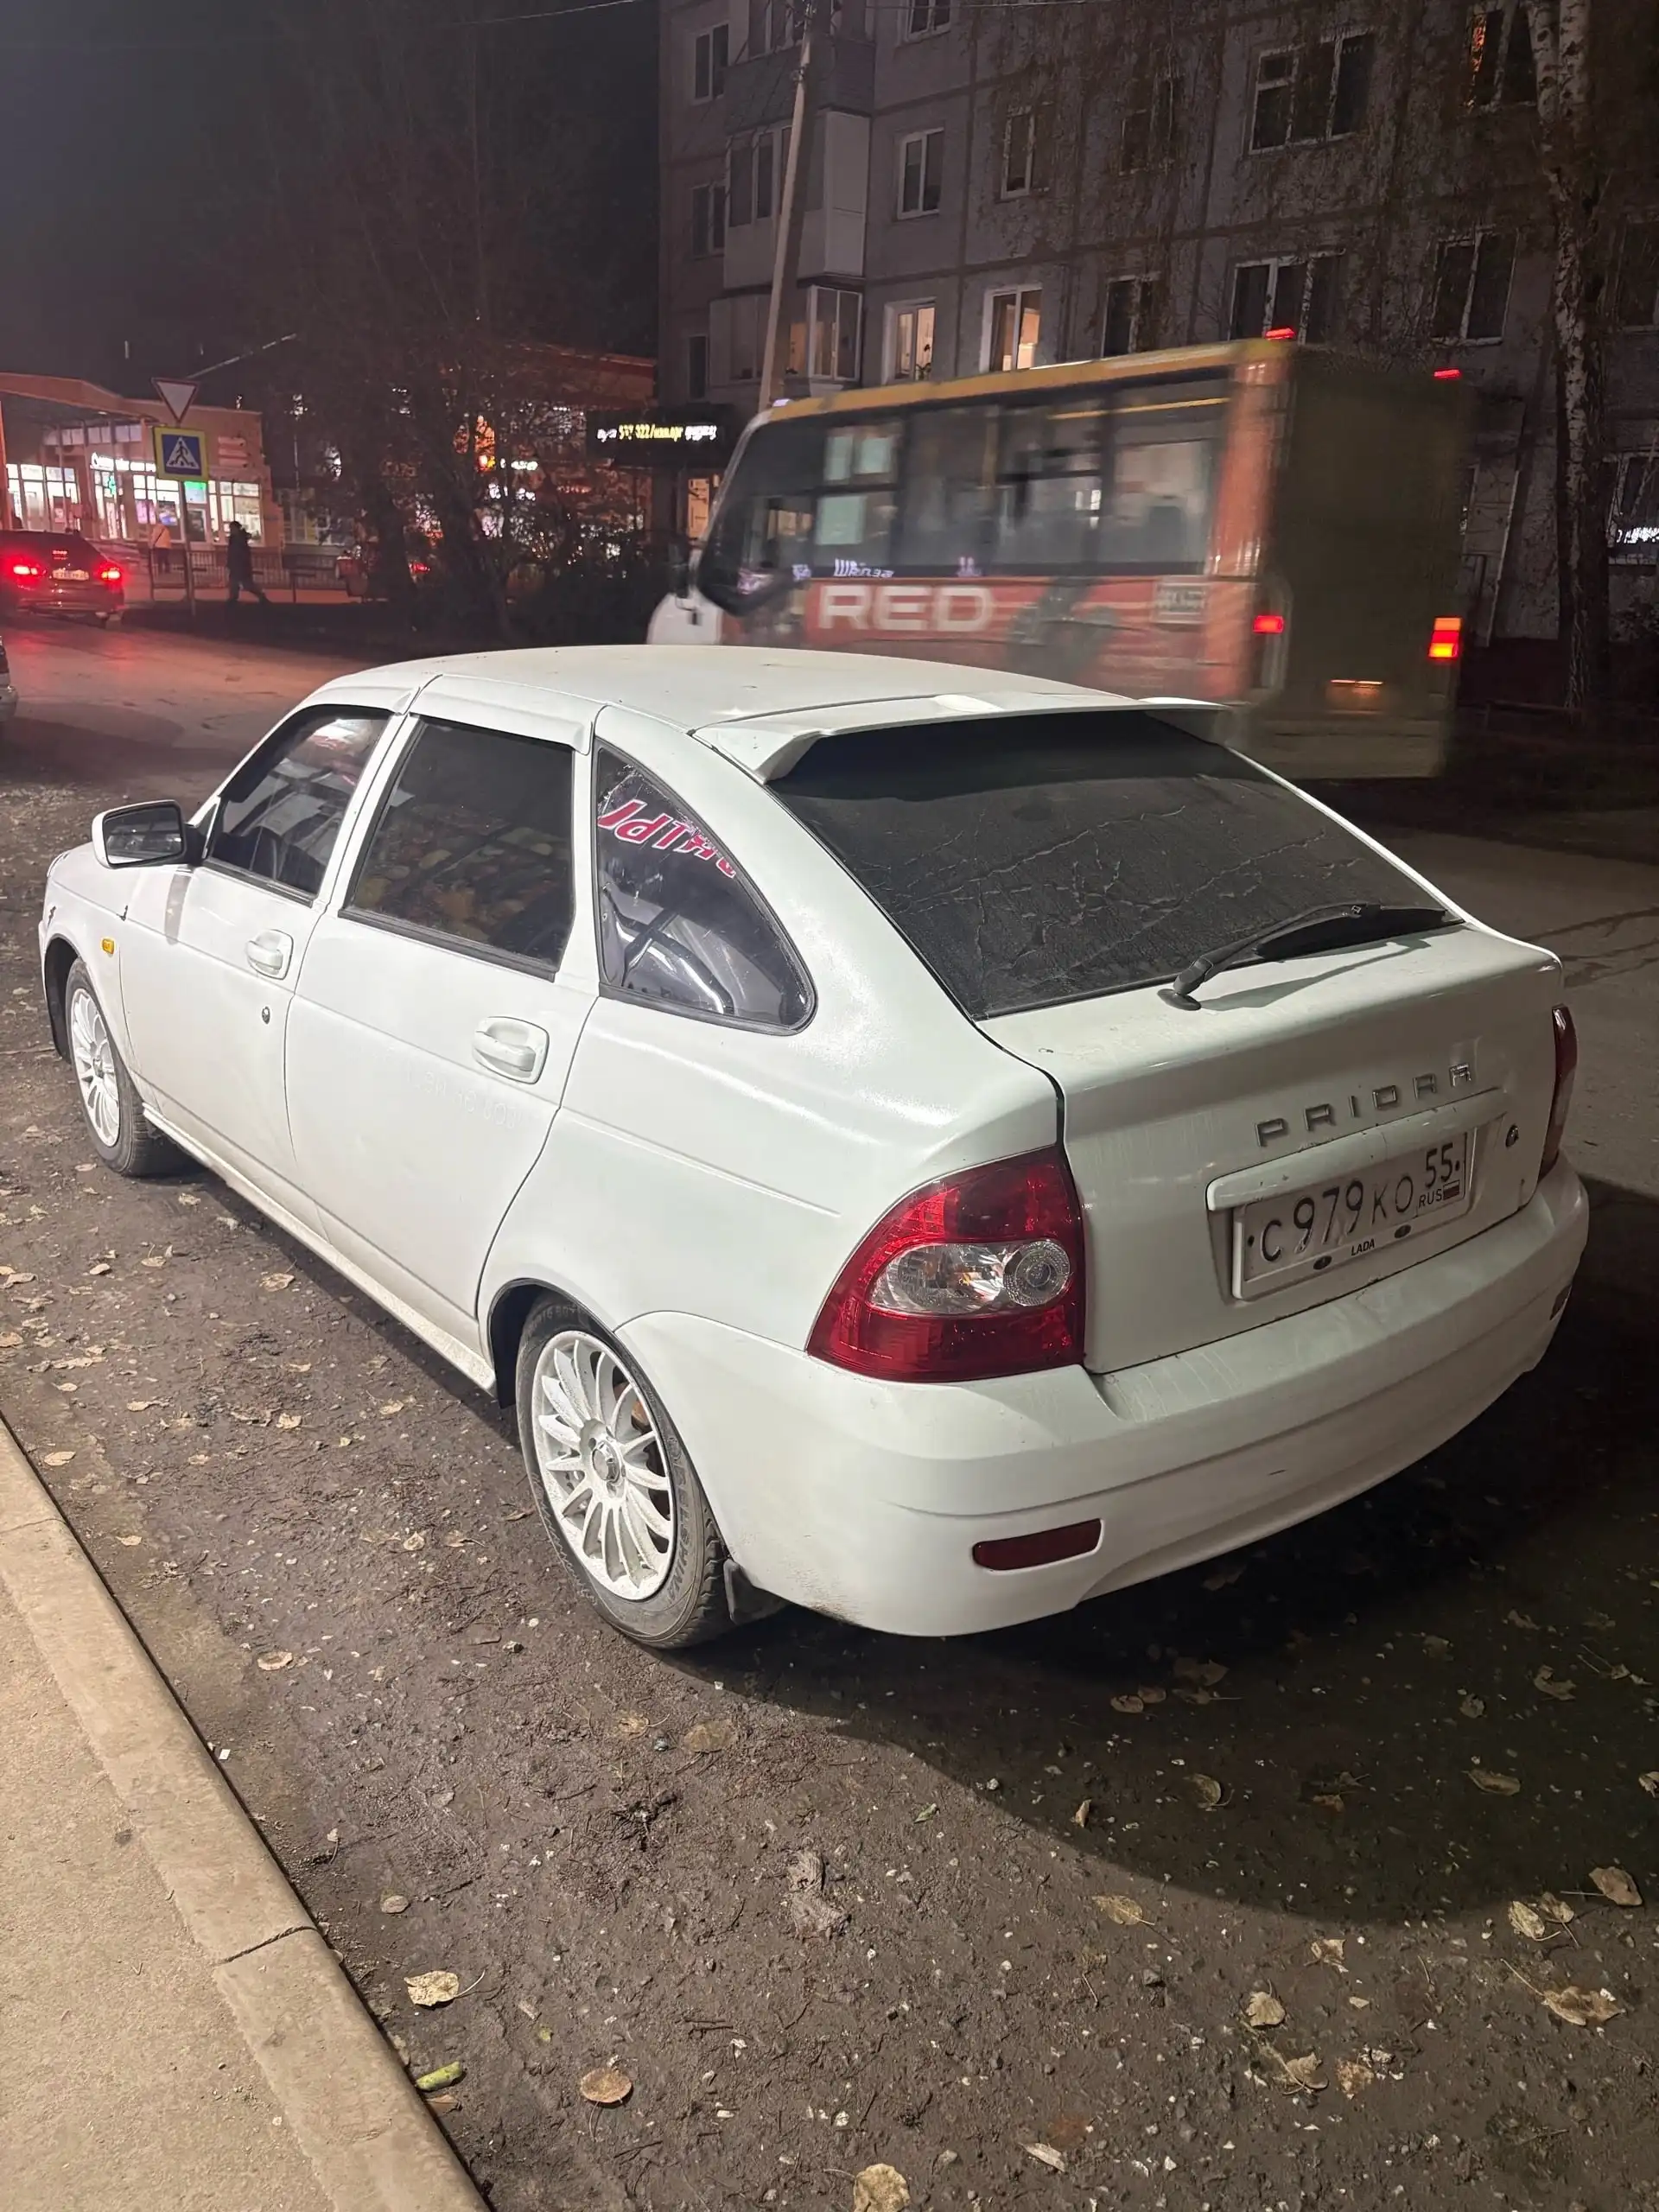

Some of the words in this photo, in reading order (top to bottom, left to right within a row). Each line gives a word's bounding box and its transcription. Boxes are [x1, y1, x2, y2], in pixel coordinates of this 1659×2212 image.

[819, 586, 993, 632] RED
[1255, 1064, 1471, 1147] PRIORA
[1425, 1142, 1453, 1188] 55
[1418, 1189, 1442, 1209] RUS
[1351, 1238, 1376, 1255] LADA
